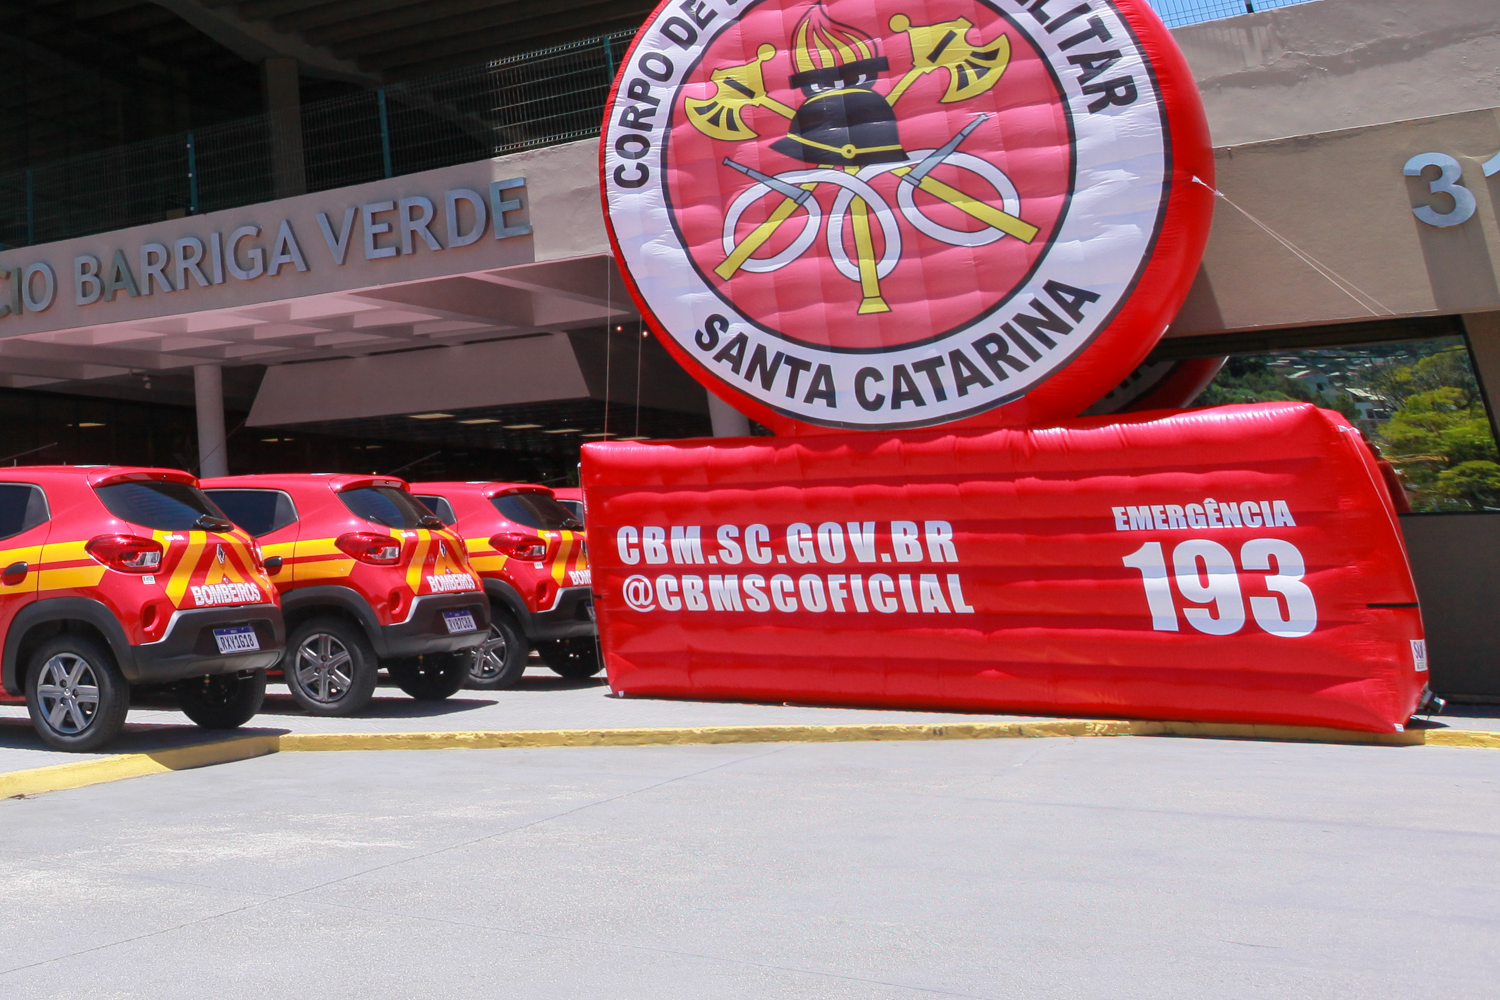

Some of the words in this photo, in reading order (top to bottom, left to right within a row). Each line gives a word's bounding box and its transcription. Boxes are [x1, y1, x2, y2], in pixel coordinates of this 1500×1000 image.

[613, 49, 675, 189] CORPO
[1403, 152, 1500, 227] 3
[74, 218, 309, 306] BARRIGA
[316, 176, 532, 265] VERDE
[694, 313, 838, 409] SANTA
[853, 278, 1102, 412] CATARINA
[616, 520, 959, 566] CBM.SC.GOV.BR
[1111, 497, 1297, 531] EMERGÊNCIA
[190, 582, 261, 606] BOMBEIROS
[426, 573, 476, 592] BOMBEIROS
[622, 572, 975, 615] @CBMSCOFICIAL
[1122, 537, 1318, 637] 193
